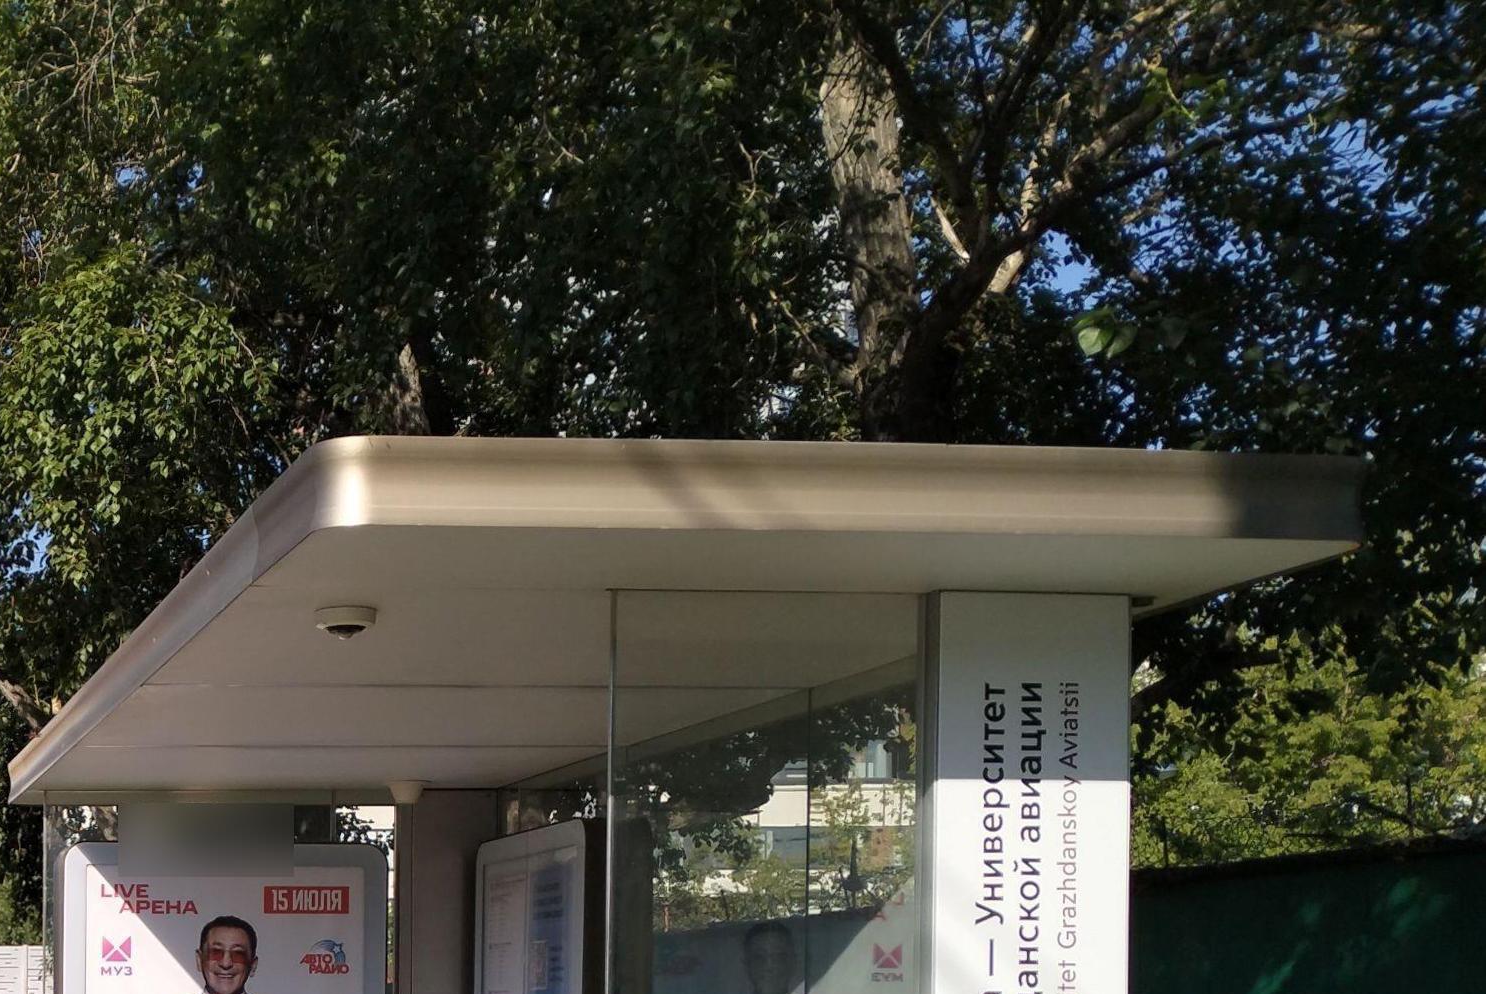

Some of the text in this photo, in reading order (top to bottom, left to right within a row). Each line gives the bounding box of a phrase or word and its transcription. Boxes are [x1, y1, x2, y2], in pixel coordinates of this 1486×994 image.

[1059, 681, 1079, 769] Aviatsii
[1020, 682, 1047, 843] авиации
[975, 682, 1010, 925] Университет
[1057, 775, 1082, 949] Grazhdanskoy
[101, 883, 149, 898] LIVE
[119, 900, 199, 914] АРЕНА
[271, 889, 342, 911] 15 ИЮЛЯ
[300, 953, 333, 964] АВТО
[100, 966, 133, 976] МУЗ
[309, 964, 350, 974] РАДИО
